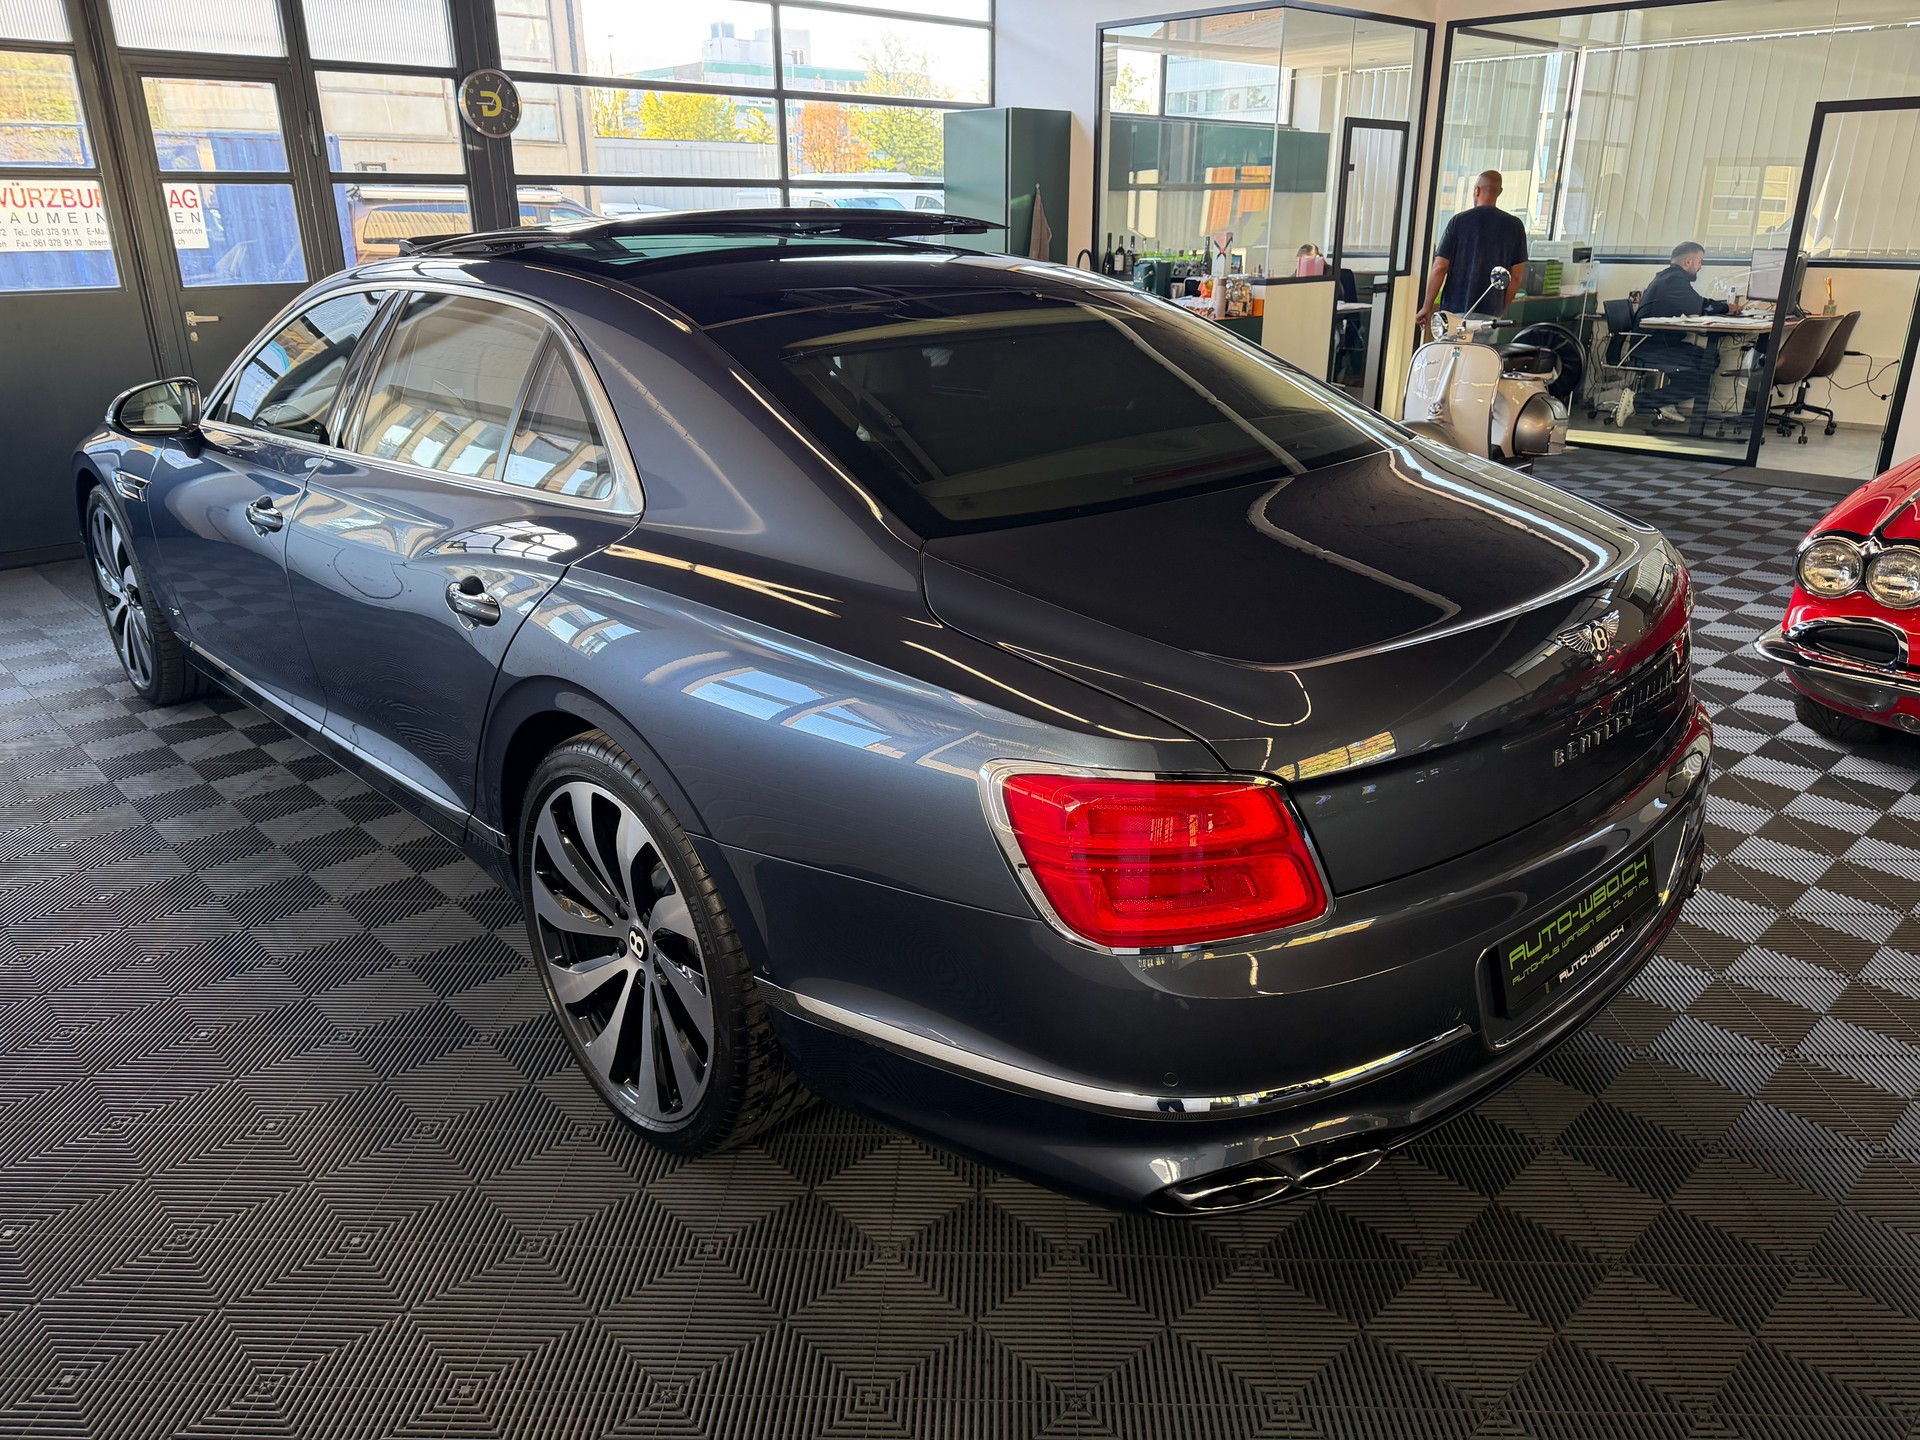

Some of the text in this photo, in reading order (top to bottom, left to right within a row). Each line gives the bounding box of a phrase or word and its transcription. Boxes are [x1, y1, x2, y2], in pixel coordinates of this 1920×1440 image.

[169, 189, 199, 208] AG
[0, 211, 201, 224] AUMEIN EN
[31, 228, 44, 236] 061
[46, 228, 60, 236] 378
[62, 228, 70, 236] 91
[33, 239, 46, 247] 061
[48, 239, 62, 247] 378
[64, 239, 72, 247] 91
[74, 239, 83, 247] 10
[88, 238, 111, 247] Intern
[629, 930, 645, 959] B
[1512, 945, 1560, 986] AUTOHAUS
